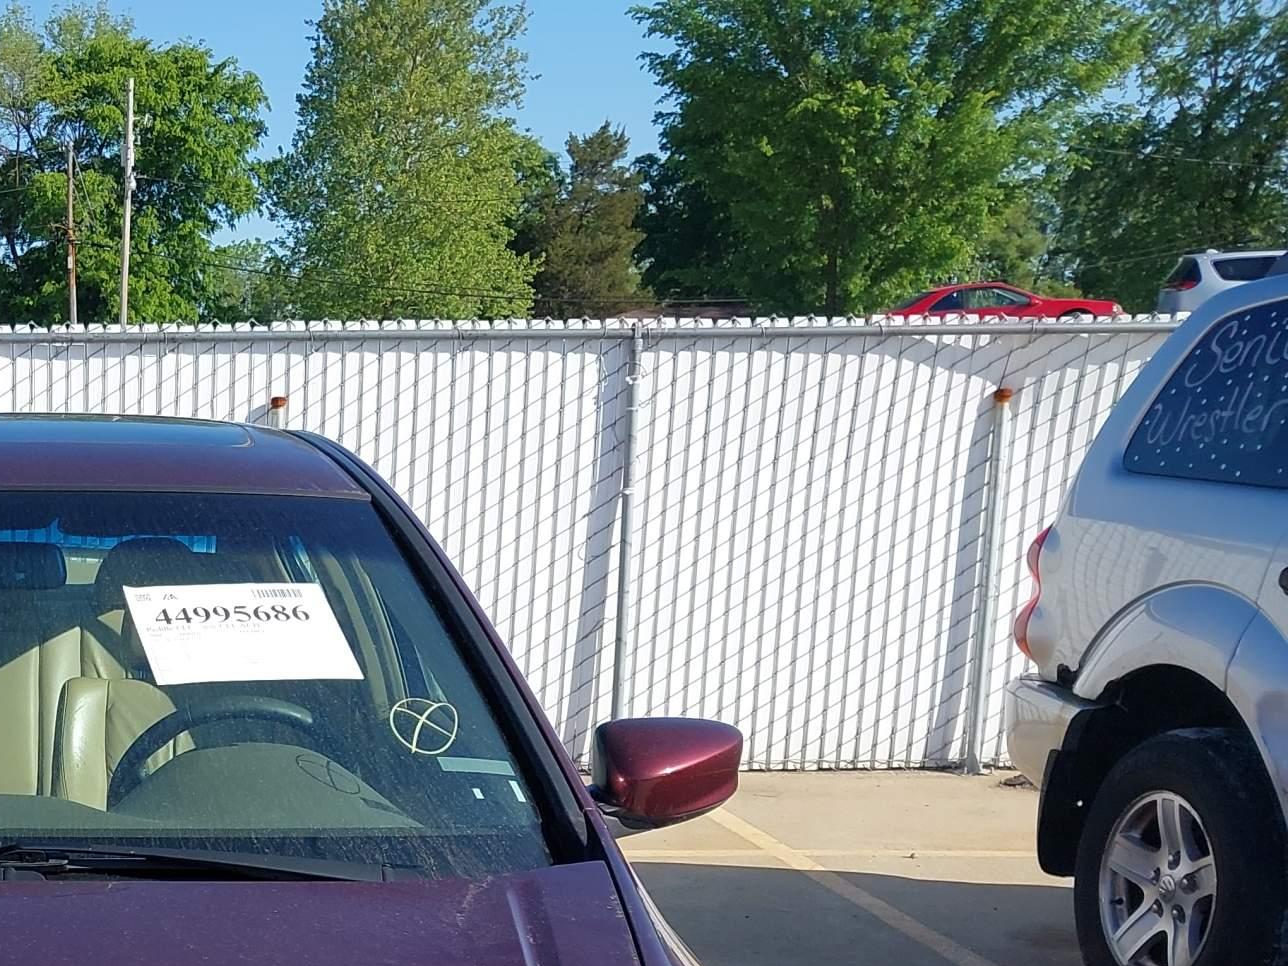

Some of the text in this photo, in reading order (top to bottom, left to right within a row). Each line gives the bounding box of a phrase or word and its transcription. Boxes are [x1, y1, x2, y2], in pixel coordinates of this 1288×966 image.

[1184, 320, 1288, 388] Seni
[1146, 381, 1288, 446] Wrestler
[155, 604, 311, 625] 44995686
